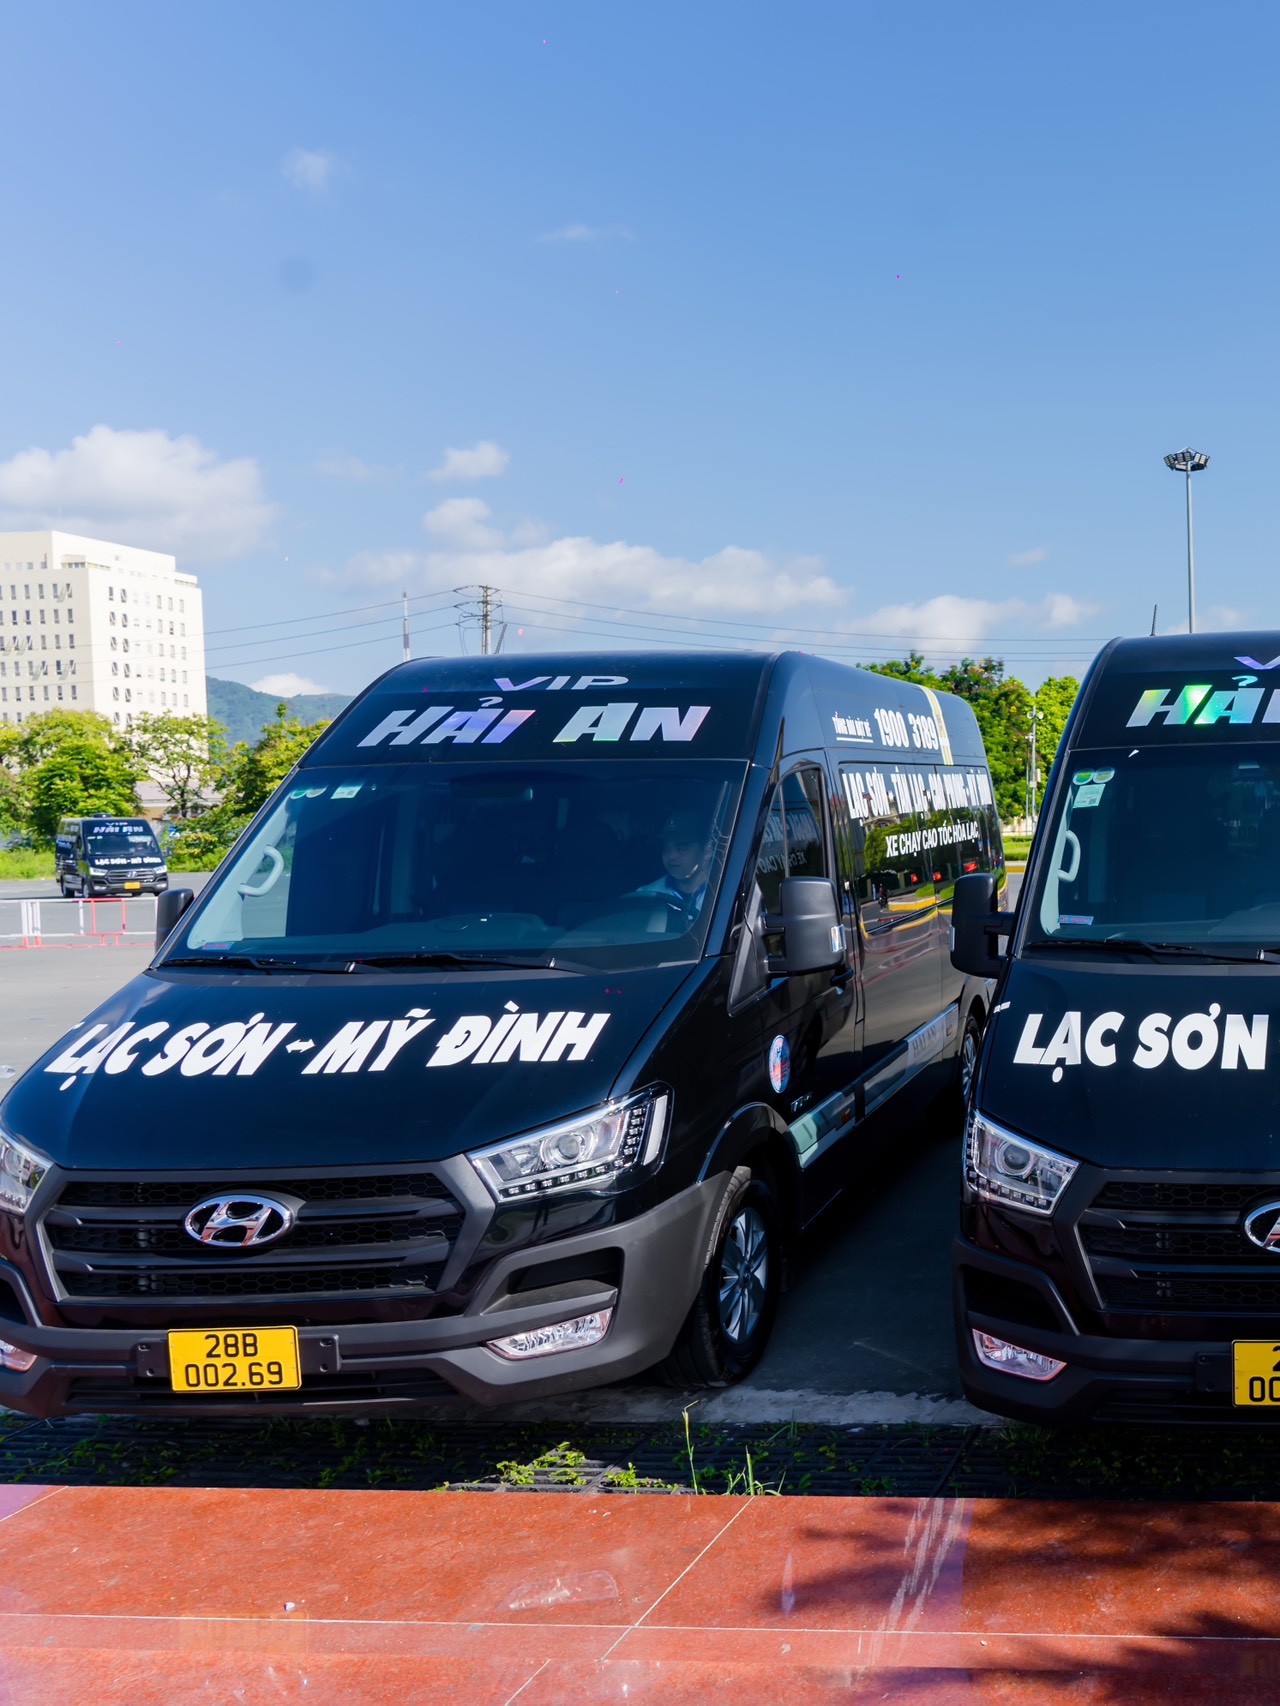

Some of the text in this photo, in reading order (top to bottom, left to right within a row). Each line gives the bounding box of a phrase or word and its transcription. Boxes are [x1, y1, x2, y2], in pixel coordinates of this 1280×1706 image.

[494, 675, 629, 691] VIP
[356, 696, 711, 747] HẢI AN
[874, 708, 939, 750] 1900 3189
[885, 818, 979, 858] XE CHẠY CAO TỐC HÒA LẠC
[44, 1000, 611, 1091] LẠC SƠN MỸ ĐÌNH
[1013, 1011, 1126, 1083] LẠC
[1132, 1003, 1269, 1070] SƠN
[204, 1333, 258, 1358] 28B
[185, 1361, 283, 1387] 002.69
